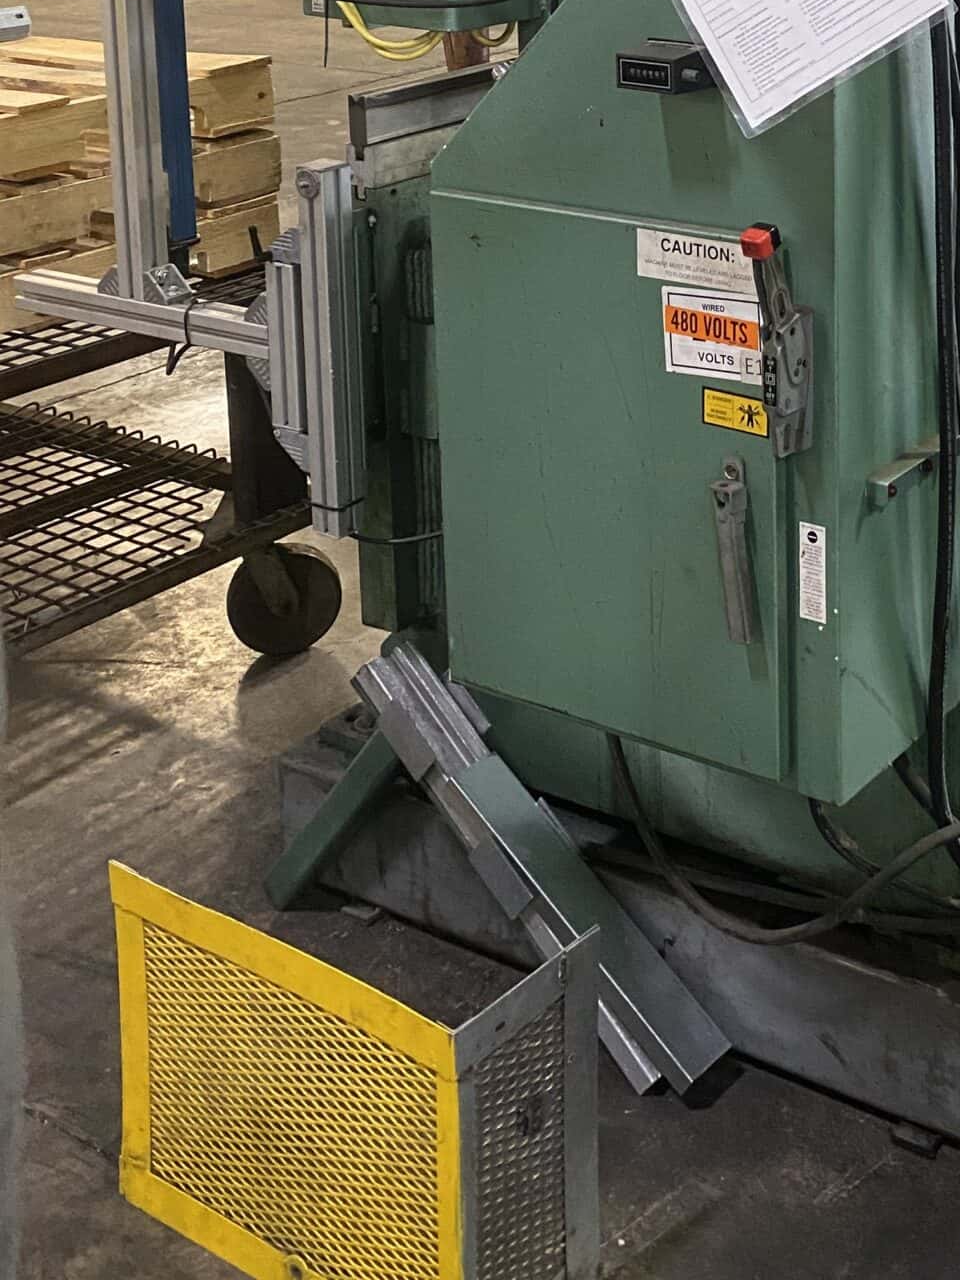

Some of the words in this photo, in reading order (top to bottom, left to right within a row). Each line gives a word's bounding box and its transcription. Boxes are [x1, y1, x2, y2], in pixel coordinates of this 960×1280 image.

[661, 238, 735, 263] CAUTION:
[701, 303, 725, 313] WIRED
[671, 310, 698, 334] 480
[703, 315, 748, 344] VOLTS
[698, 351, 734, 366] VOLTS
